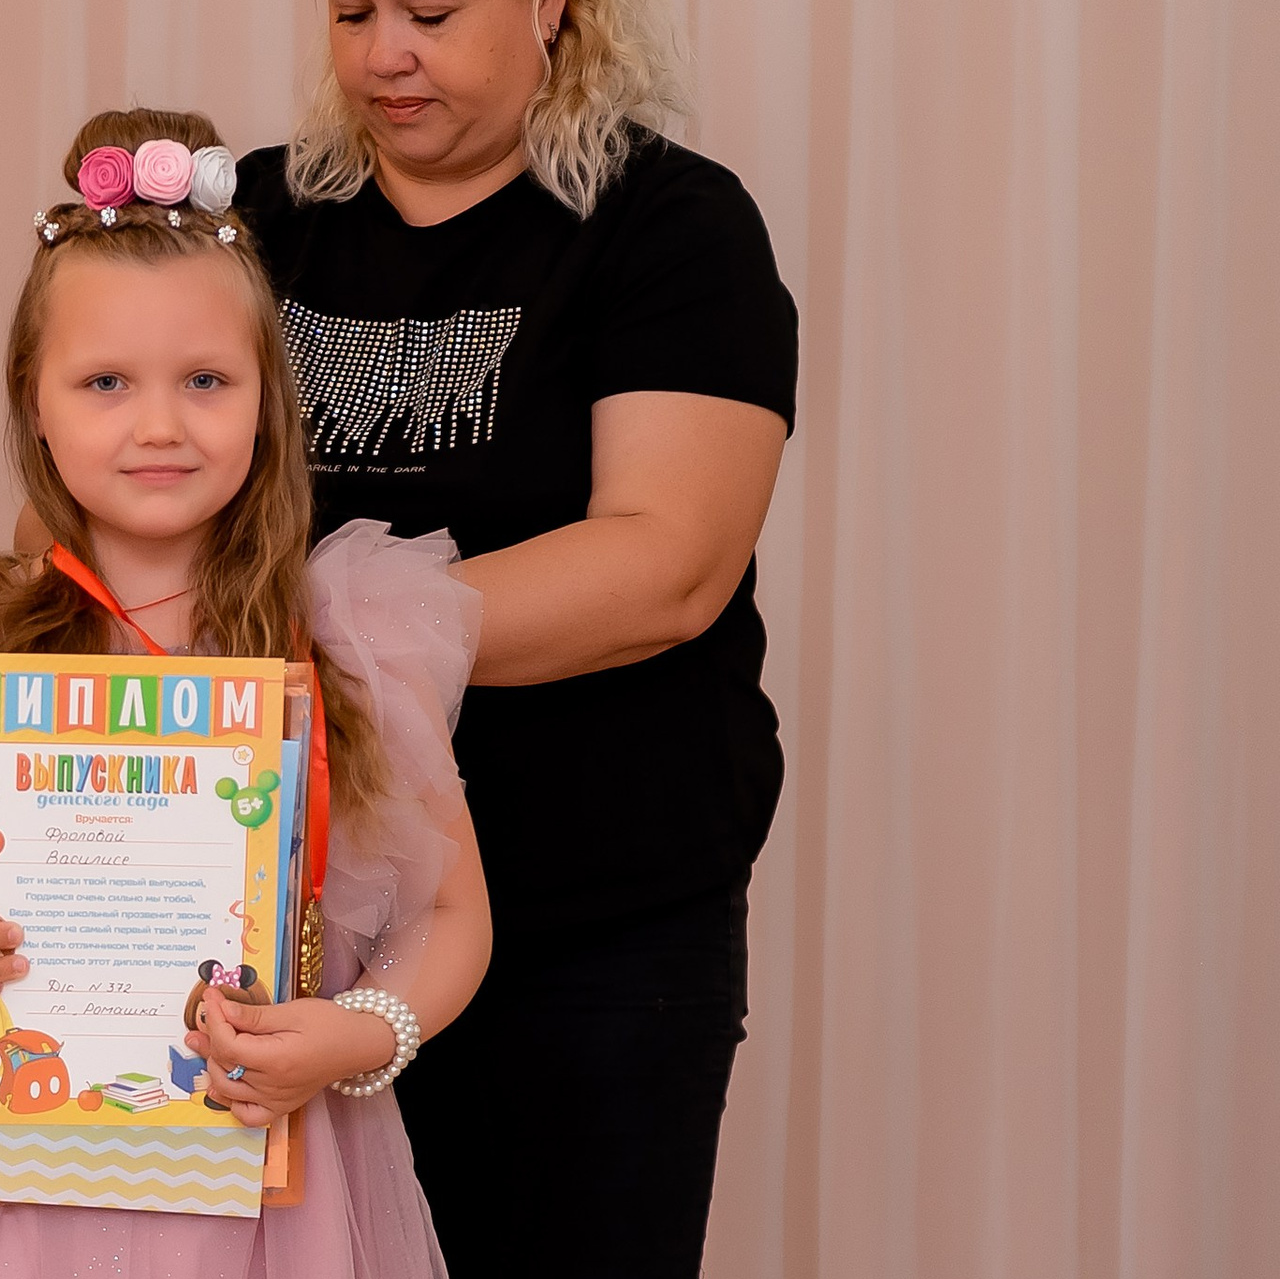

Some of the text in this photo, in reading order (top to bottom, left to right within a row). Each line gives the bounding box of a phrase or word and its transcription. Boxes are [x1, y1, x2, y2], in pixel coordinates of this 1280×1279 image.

[306, 464, 342, 472] ARKLE
[16, 753, 198, 794] ВЫПУСКНИКА
[37, 794, 169, 811] детского сада
[238, 797, 263, 815] 5+
[75, 814, 133, 824] Вручается:
[46, 850, 130, 866] Василисе
[17, 876, 34, 885] Вот
[84, 877, 106, 886] твой
[109, 877, 146, 887] первый
[25, 893, 74, 902] Гордимся
[77, 894, 105, 902] очень
[108, 894, 143, 902] сильно
[146, 895, 160, 903] мы
[9, 909, 211, 920] Ведь скоро школьный прозвенит звонок
[80, 924, 111, 934] самый
[114, 925, 151, 935] первый
[154, 926, 178, 935] твой
[180, 927, 207, 936] урок!
[42, 941, 66, 949] быть
[68, 942, 129, 951] отличником
[132, 942, 154, 951] тебе
[37, 957, 85, 966] радостью
[88, 958, 110, 966] этот
[113, 959, 151, 968] диплом
[154, 959, 198, 968] вручаем!
[106, 982, 133, 994] 372
